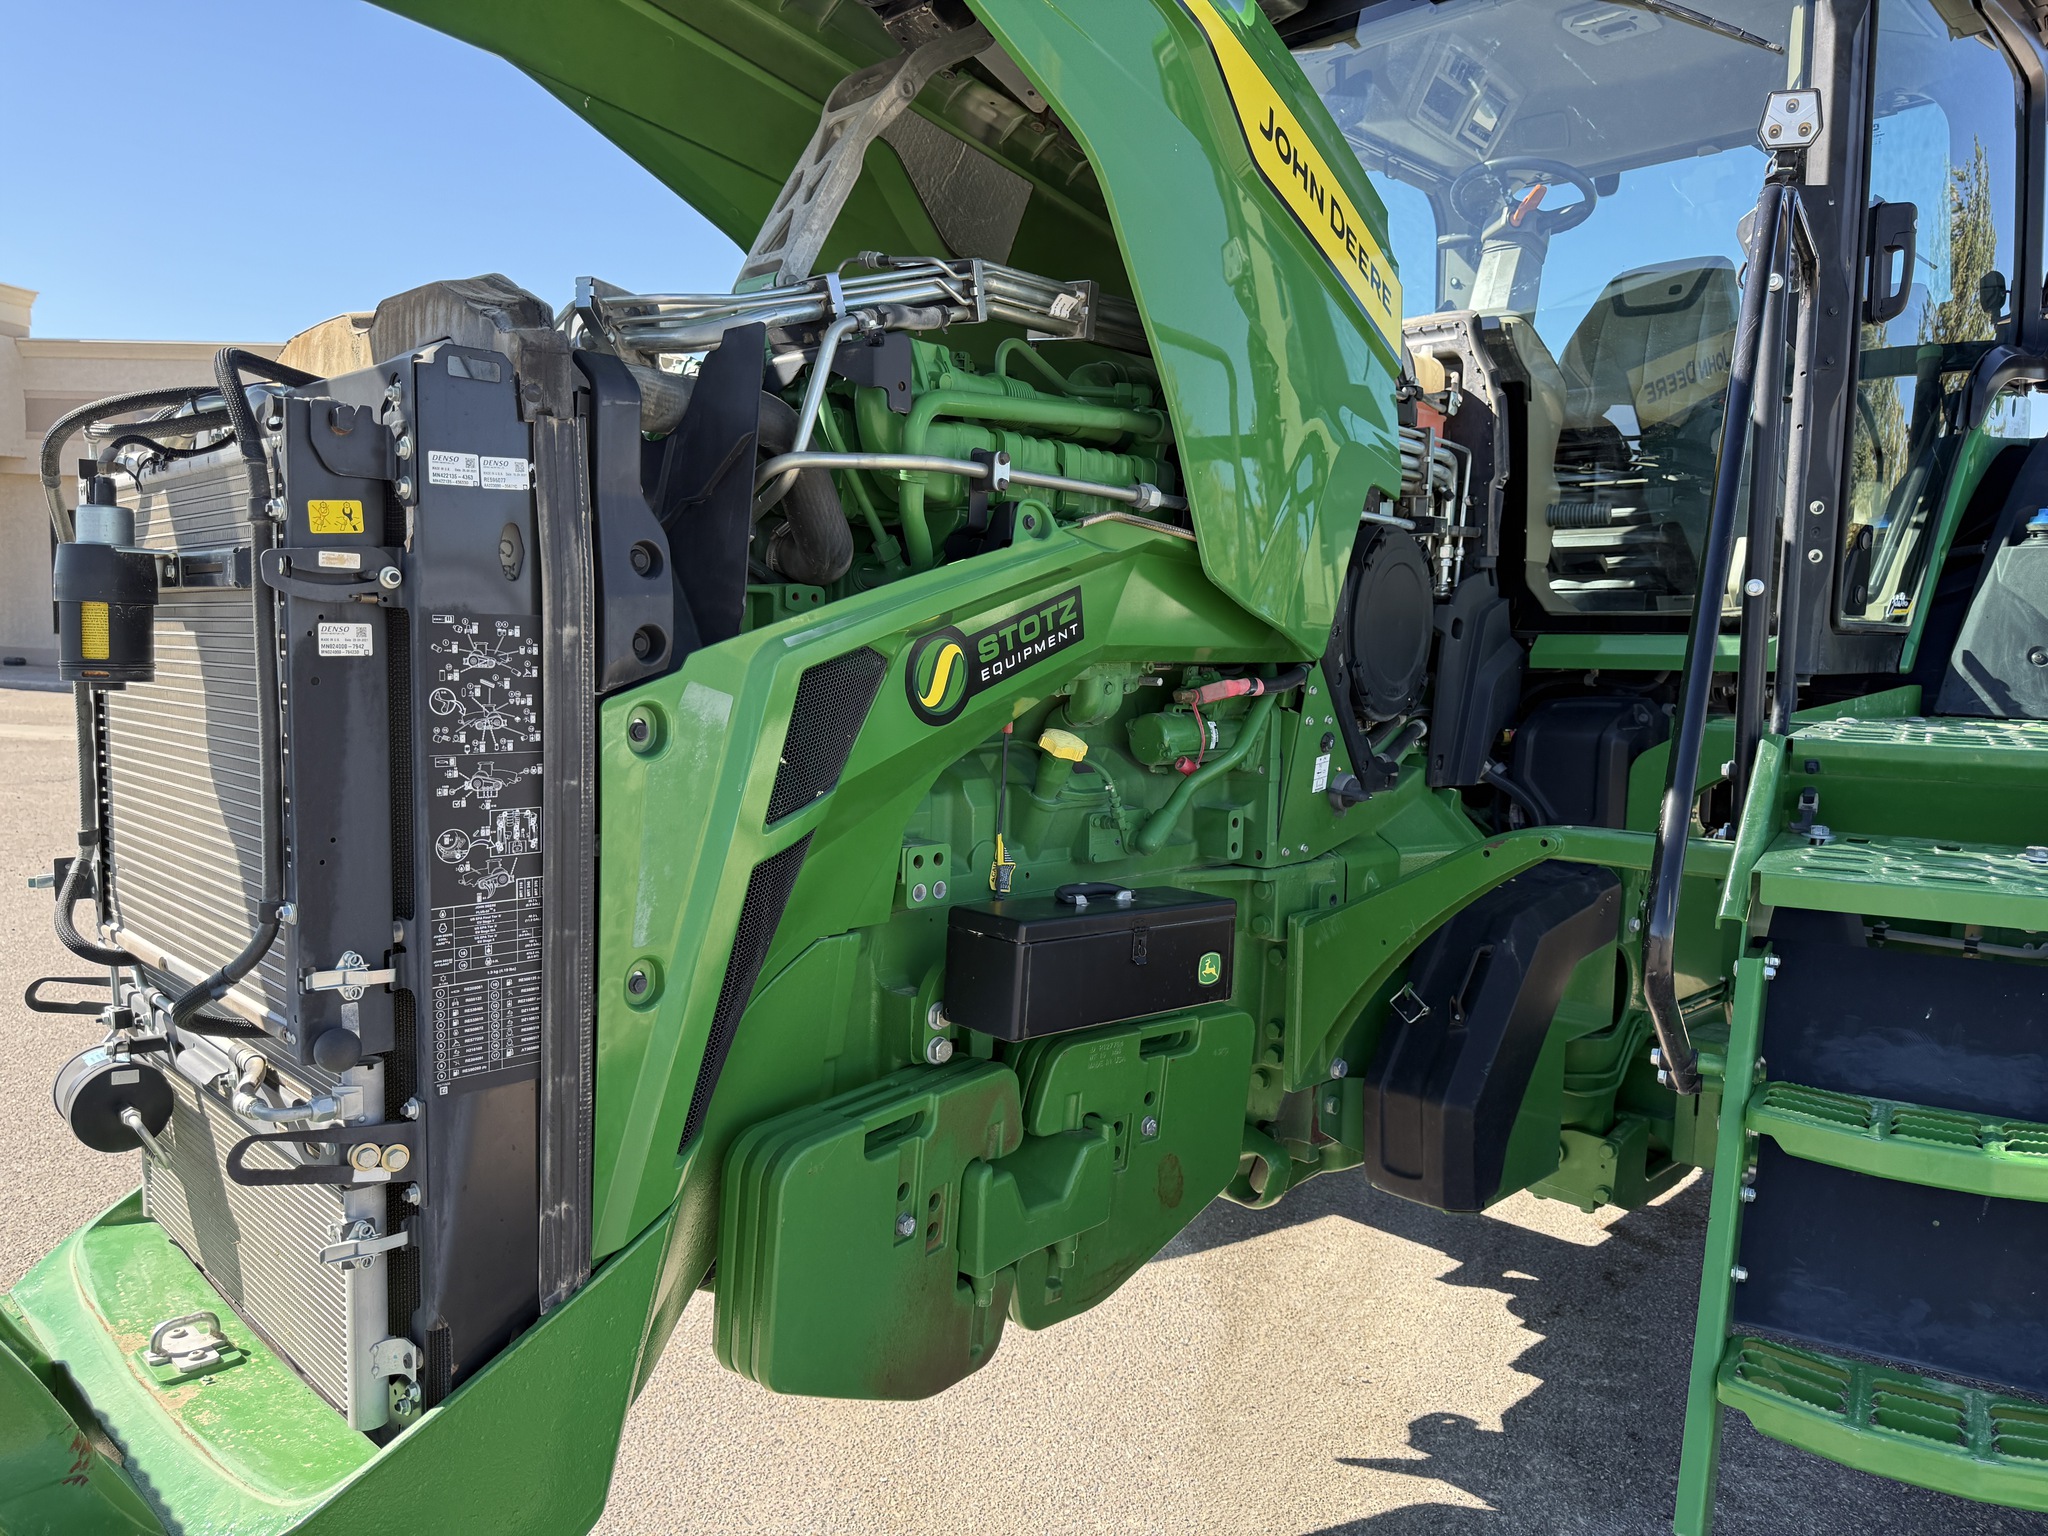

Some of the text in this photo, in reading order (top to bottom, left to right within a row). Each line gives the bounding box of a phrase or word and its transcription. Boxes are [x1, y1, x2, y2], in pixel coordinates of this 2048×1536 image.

[1259, 106, 1393, 317] JOHN DEERE
[977, 596, 1078, 664] STOTZ
[981, 623, 1079, 682] EQUIPMENT
